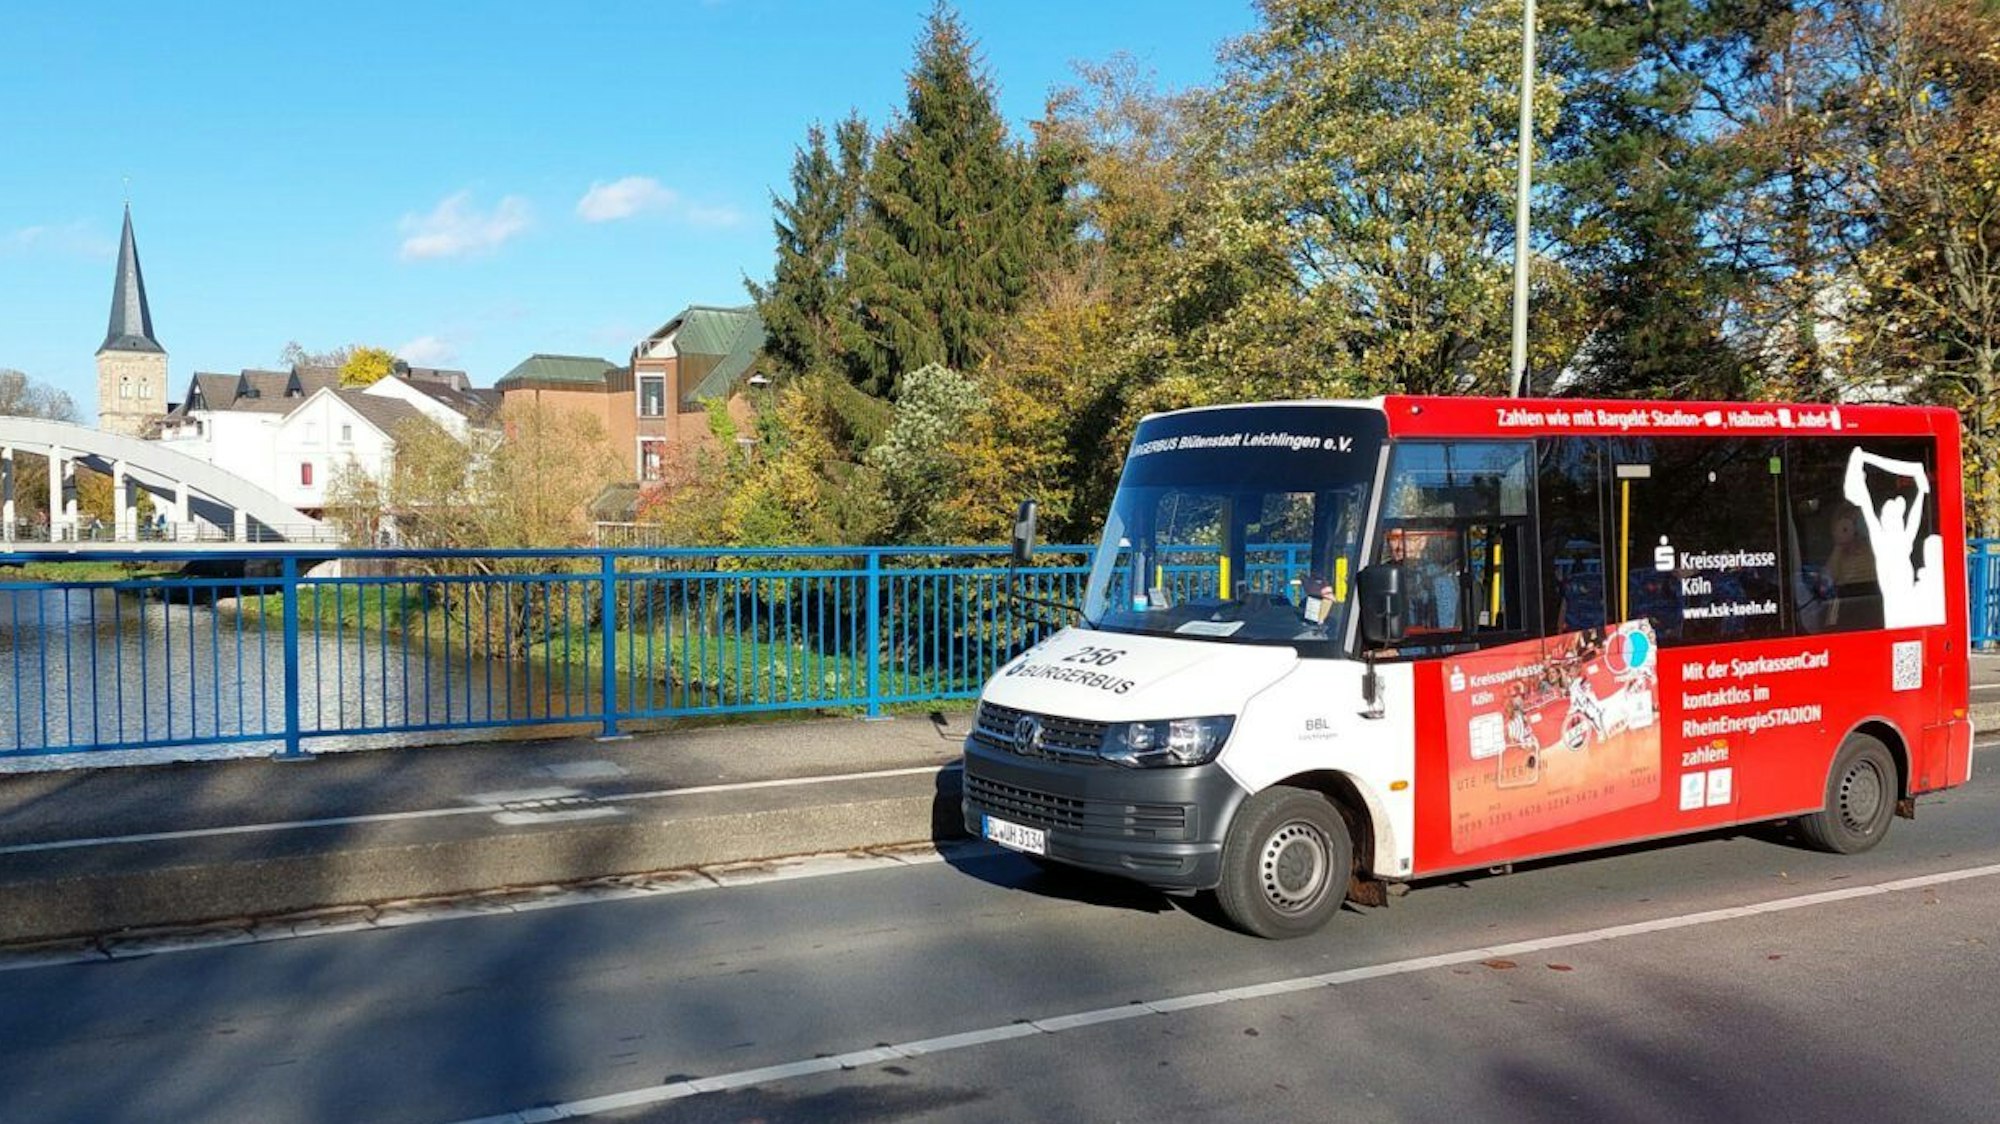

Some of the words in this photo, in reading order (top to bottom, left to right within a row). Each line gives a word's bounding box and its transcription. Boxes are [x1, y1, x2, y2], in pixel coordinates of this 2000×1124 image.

[1496, 408, 1543, 426] Zahlen
[1546, 409, 1570, 426] wie
[1572, 409, 1596, 426] mit
[1597, 409, 1650, 430] Bargeld:
[1177, 433, 1243, 449] Blütenstadt
[1242, 432, 1319, 450] Leichlingen
[1323, 436, 1352, 453] e.V.
[1680, 549, 1776, 572] Kreissparkasse
[1682, 576, 1712, 596] Köln
[1682, 599, 1778, 619] www.ksk-koeln.de
[1062, 646, 1127, 666] 256
[1682, 662, 1704, 681] Mit
[1706, 660, 1729, 679] der
[1731, 648, 1829, 680] SparkassenCard
[1018, 663, 1135, 695] BÜRGERBUS
[1471, 664, 1544, 688] Kreissparkasse
[1471, 691, 1495, 707] Köln
[1682, 686, 1752, 710] kontaktlos
[1753, 684, 1770, 702] im
[1306, 718, 1330, 731] BBL
[1682, 704, 1822, 738] RheinEnergieSTADION
[1682, 745, 1730, 767] zahlen!
